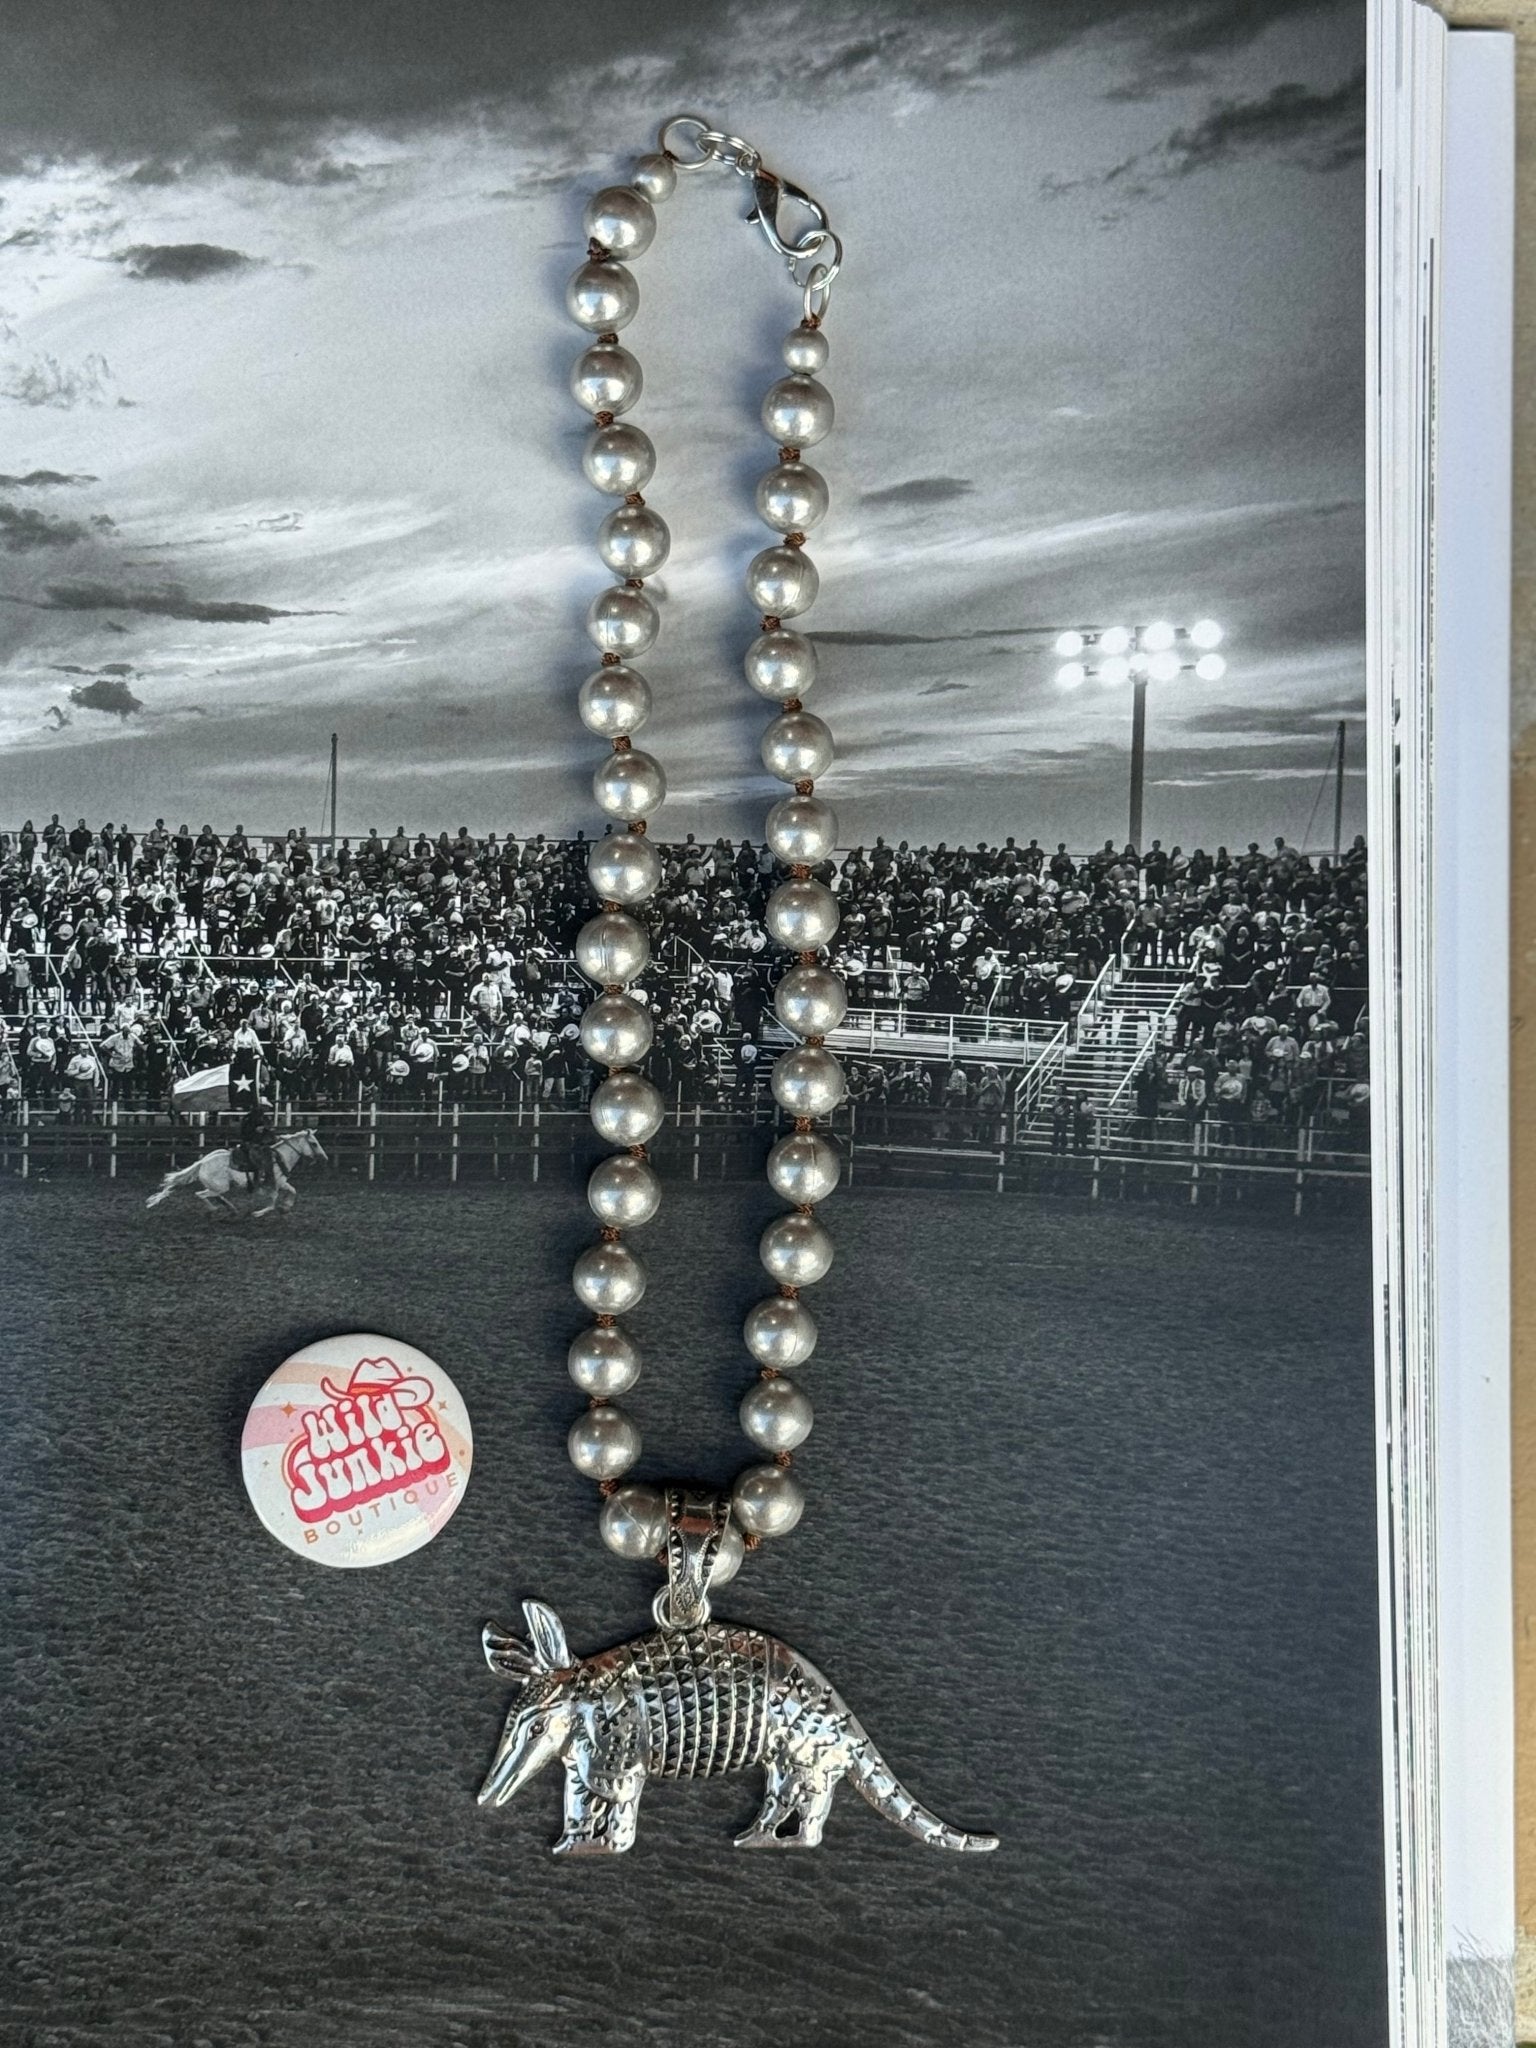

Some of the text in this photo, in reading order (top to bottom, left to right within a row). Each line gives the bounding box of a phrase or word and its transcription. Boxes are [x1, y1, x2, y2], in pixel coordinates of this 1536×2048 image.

[303, 1391, 402, 1460] Wild
[291, 1421, 447, 1512] Junkie
[303, 1471, 459, 1545] BOUTIQUE
